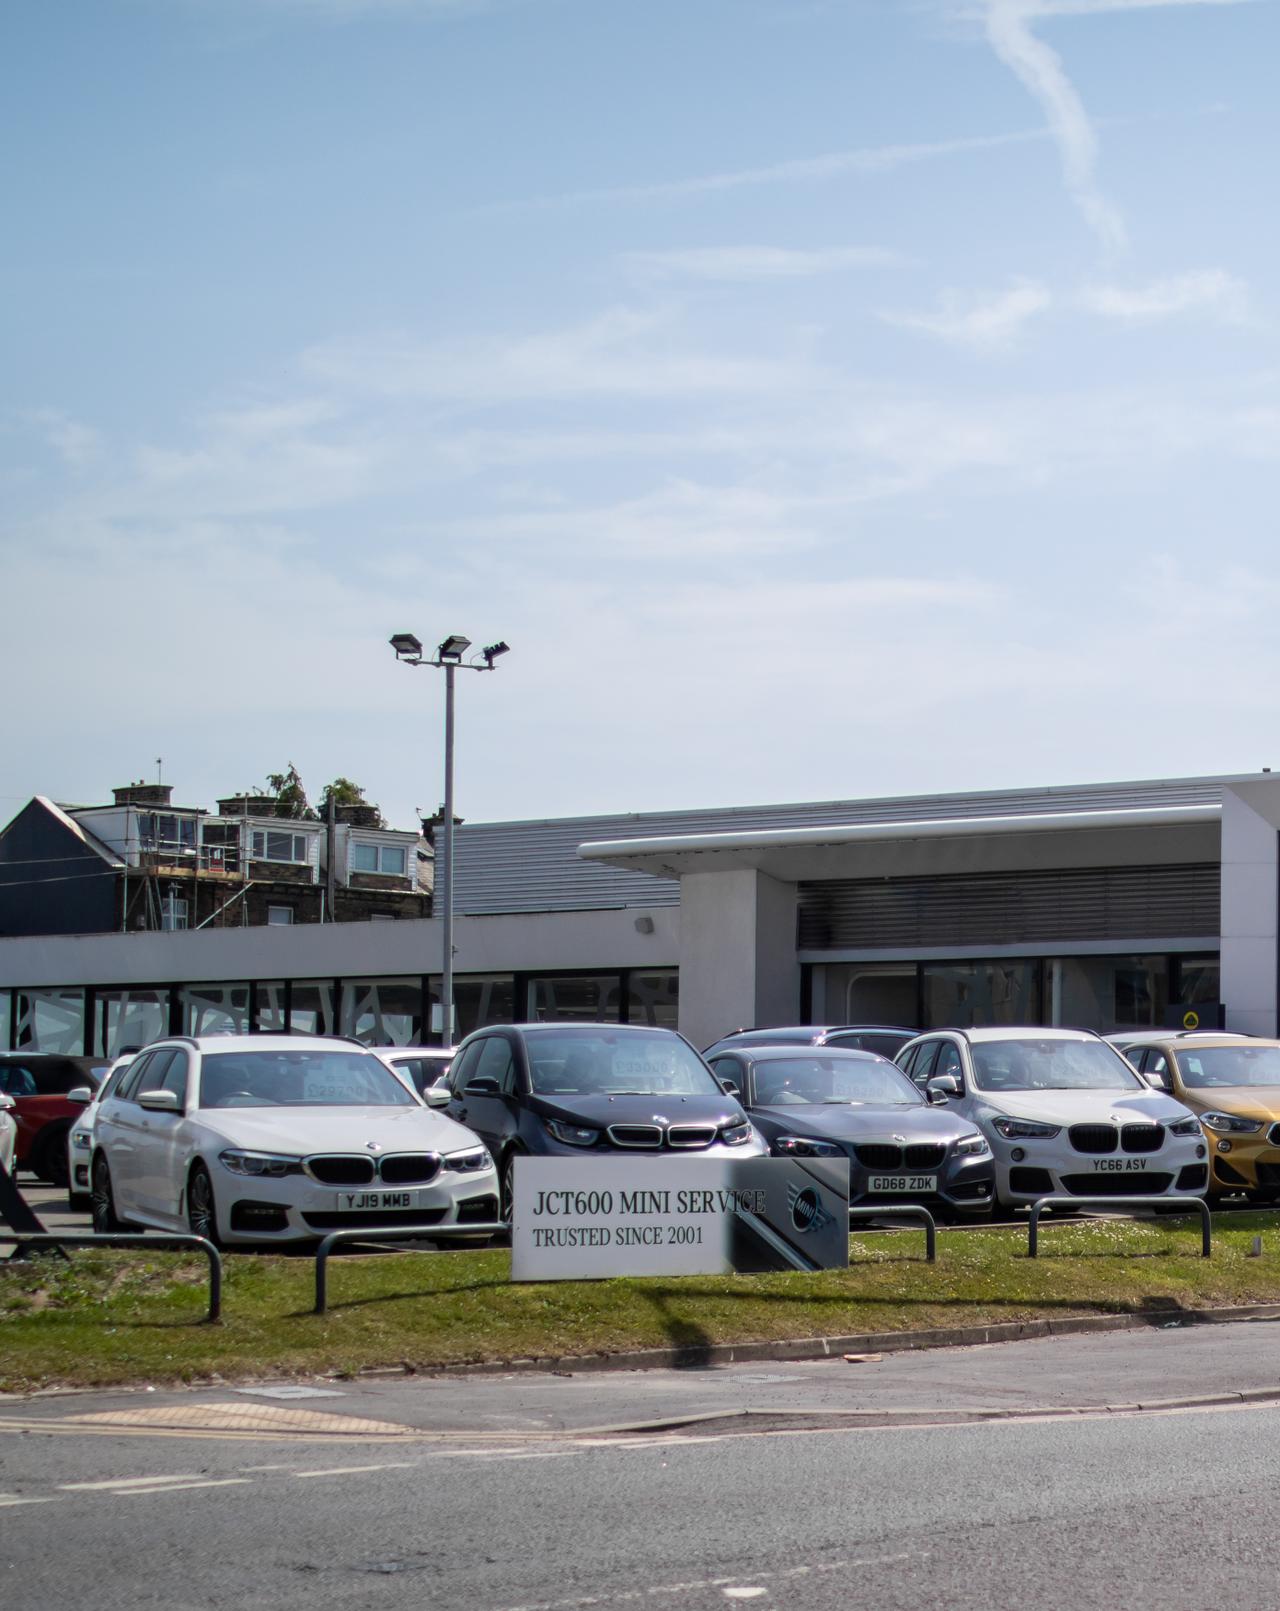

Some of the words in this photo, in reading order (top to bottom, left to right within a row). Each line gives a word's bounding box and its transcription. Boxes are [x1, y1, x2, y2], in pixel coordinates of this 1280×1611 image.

[1093, 1160, 1122, 1170] YC66
[1125, 1160, 1147, 1170] ASV
[873, 1178, 906, 1190] GD68
[909, 1178, 932, 1189] ZDK
[347, 1195, 379, 1209] YJ19
[382, 1194, 410, 1207] MMB
[533, 1191, 613, 1215] JCT600
[619, 1191, 671, 1214] MINI
[677, 1190, 766, 1213] SERVICE
[796, 1197, 815, 1217] MINI
[533, 1228, 610, 1247] TRUSTED
[615, 1227, 663, 1246] SINCE
[668, 1226, 704, 1244] 2001
